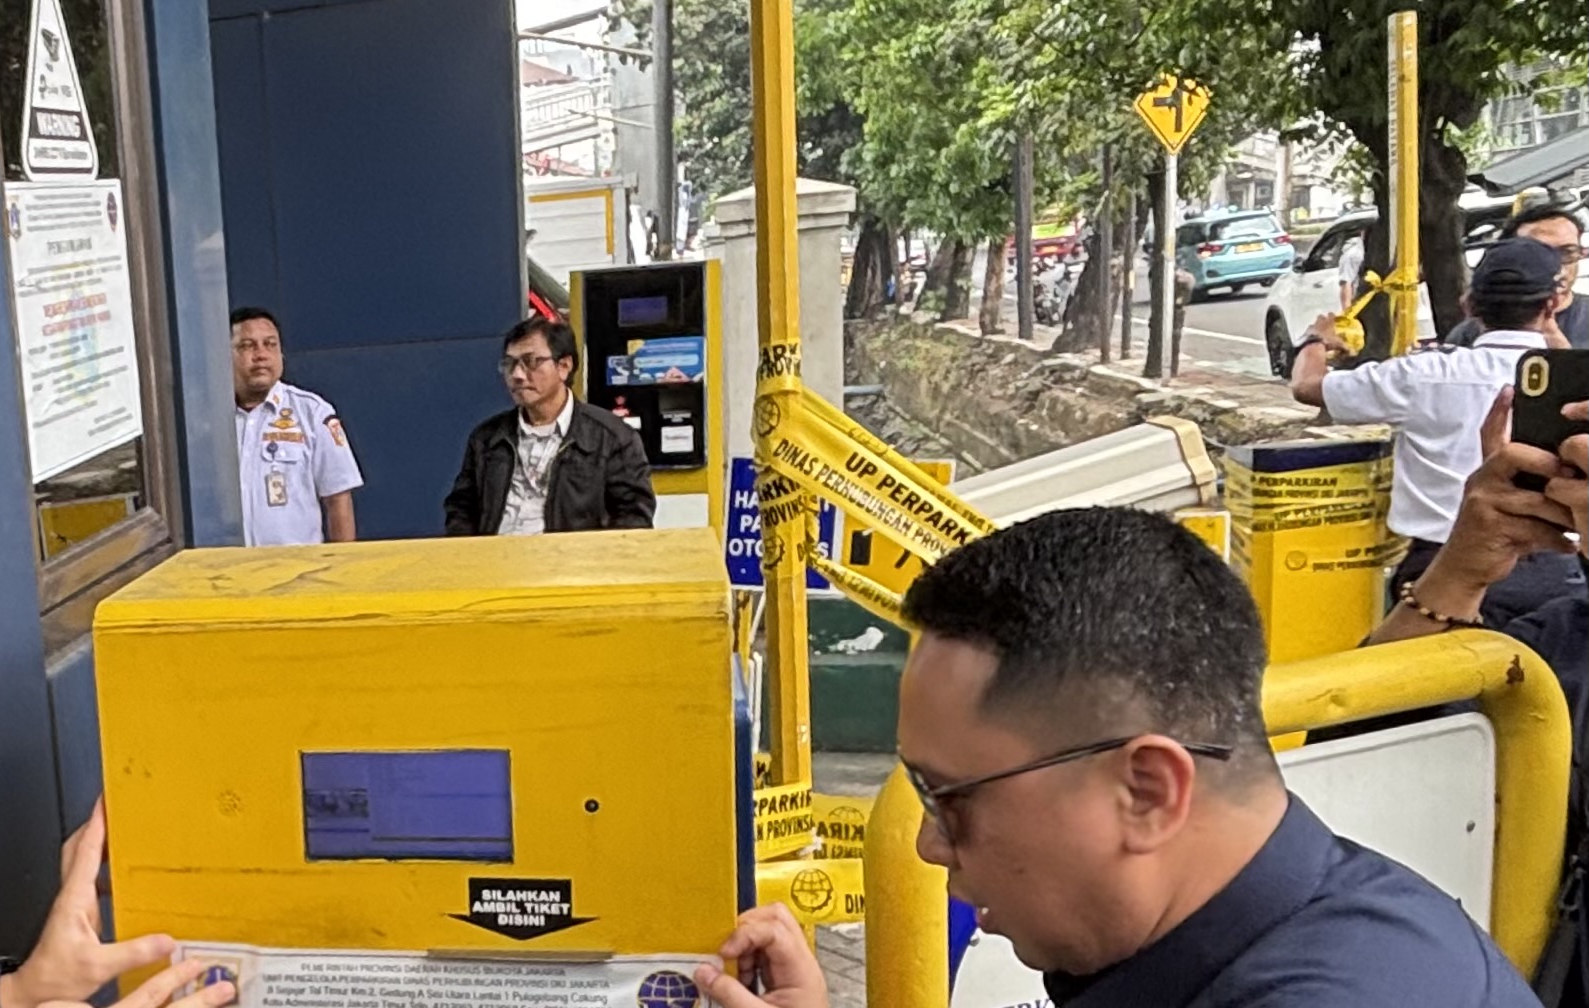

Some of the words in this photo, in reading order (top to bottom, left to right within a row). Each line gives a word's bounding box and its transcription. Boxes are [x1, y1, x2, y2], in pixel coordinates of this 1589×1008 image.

[772, 438, 820, 476] DINAS
[814, 459, 912, 537] PERHUBUNGAN
[845, 451, 878, 478] UP
[875, 473, 972, 546] PERPARK
[481, 888, 561, 904] SILAHKAN
[472, 901, 521, 916] AMBIL
[524, 902, 571, 918] TIKET
[497, 913, 545, 927] DISINI
